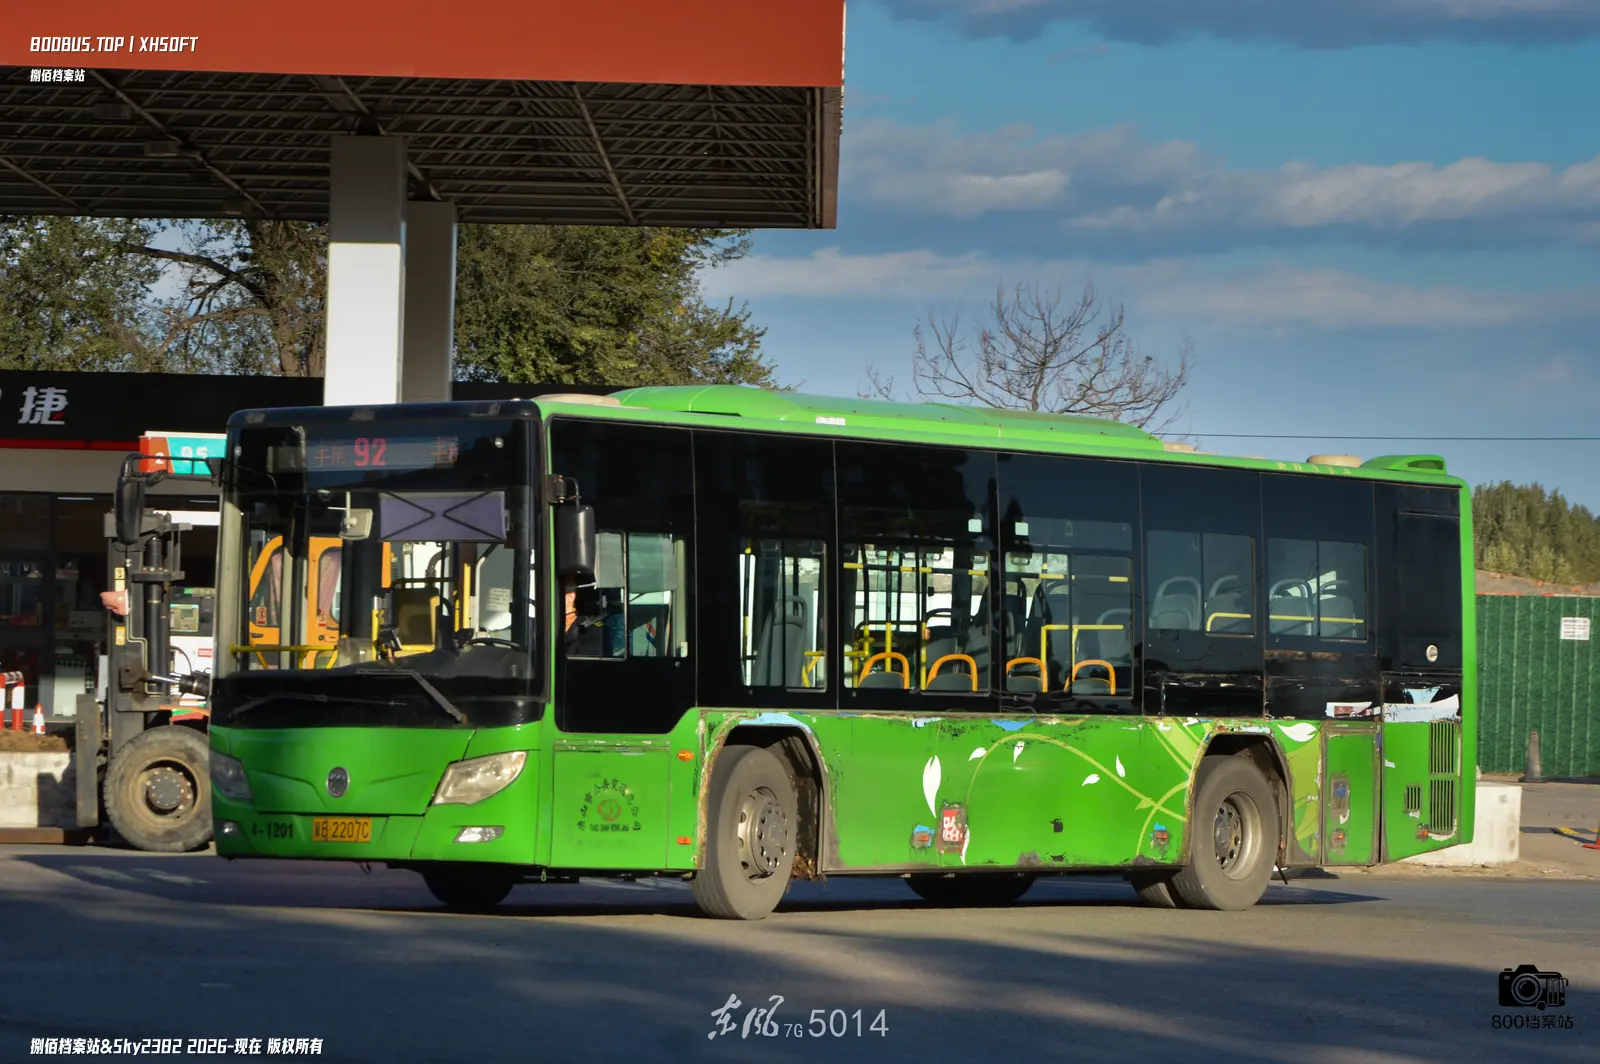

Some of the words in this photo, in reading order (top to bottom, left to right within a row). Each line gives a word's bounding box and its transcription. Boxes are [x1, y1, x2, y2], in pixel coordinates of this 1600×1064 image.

[0, 386, 68, 425] 捷
[155, 452, 165, 465] 2
[354, 438, 387, 467] 92
[252, 822, 293, 839] 4-1201
